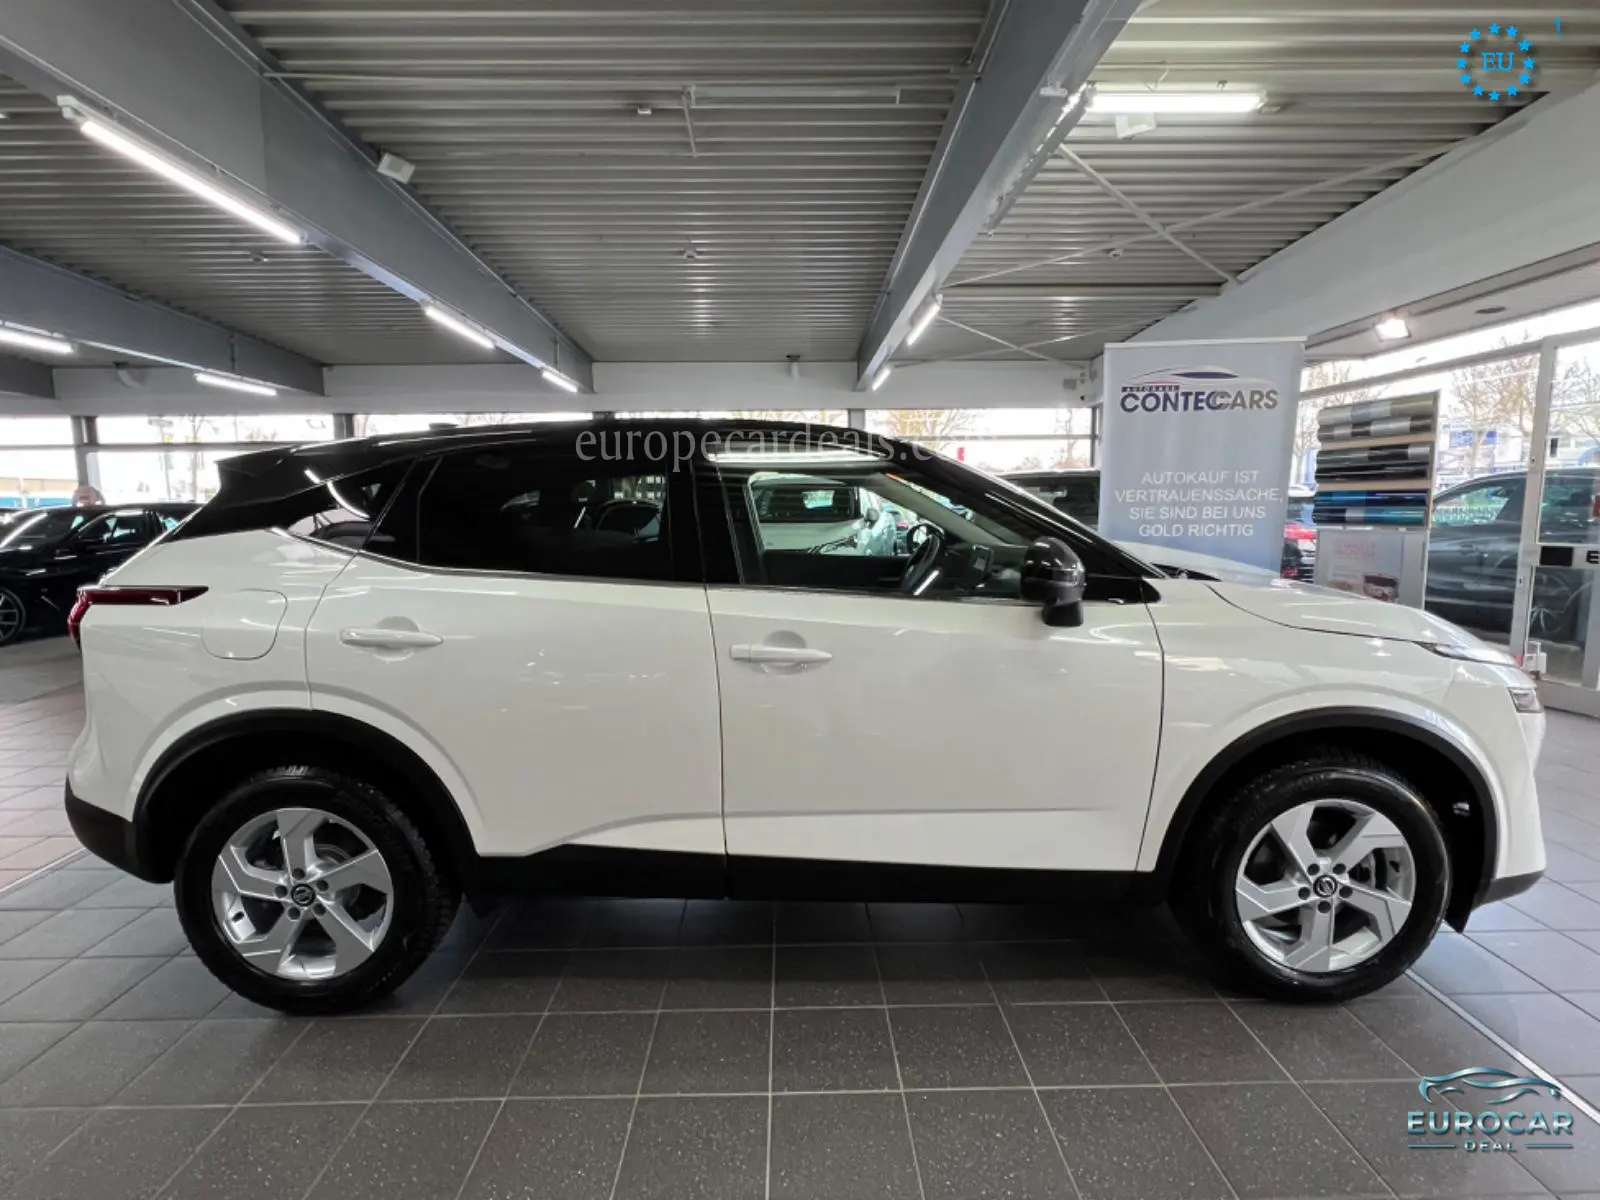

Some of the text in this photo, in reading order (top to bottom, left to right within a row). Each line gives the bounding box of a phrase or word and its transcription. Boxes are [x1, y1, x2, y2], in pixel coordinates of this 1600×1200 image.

[1141, 470, 1260, 485] AUTOKAUF IST
[1114, 488, 1283, 503] VERTRAUENSSACHE,
[1129, 506, 1267, 520] SIE SIND BEI UNS
[1138, 523, 1254, 537] GOLD RICHTIG
